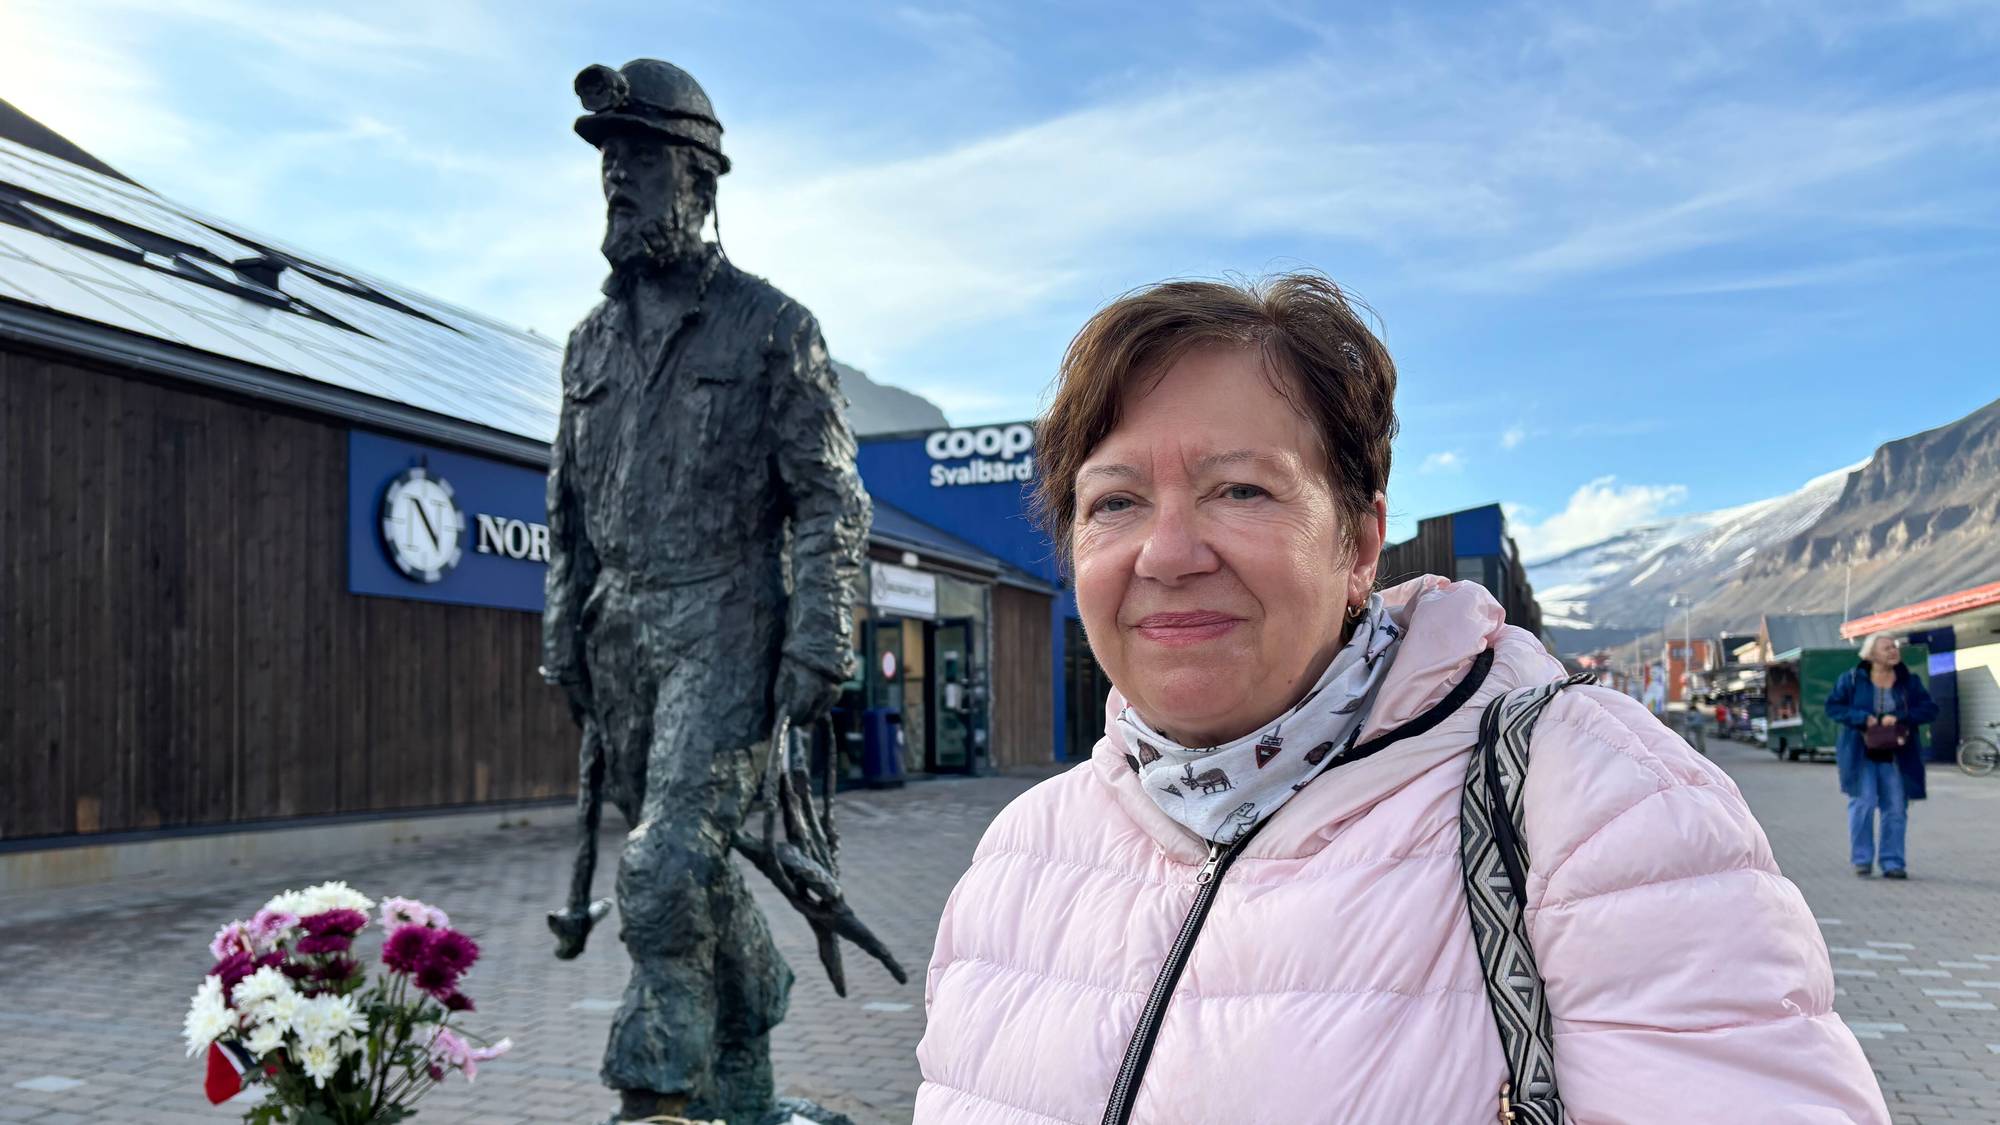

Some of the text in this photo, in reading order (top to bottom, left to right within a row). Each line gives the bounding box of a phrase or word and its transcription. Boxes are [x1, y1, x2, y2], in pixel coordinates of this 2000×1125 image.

[926, 424, 1033, 460] coop
[930, 456, 1033, 487] Svalbard
[403, 492, 448, 553] N
